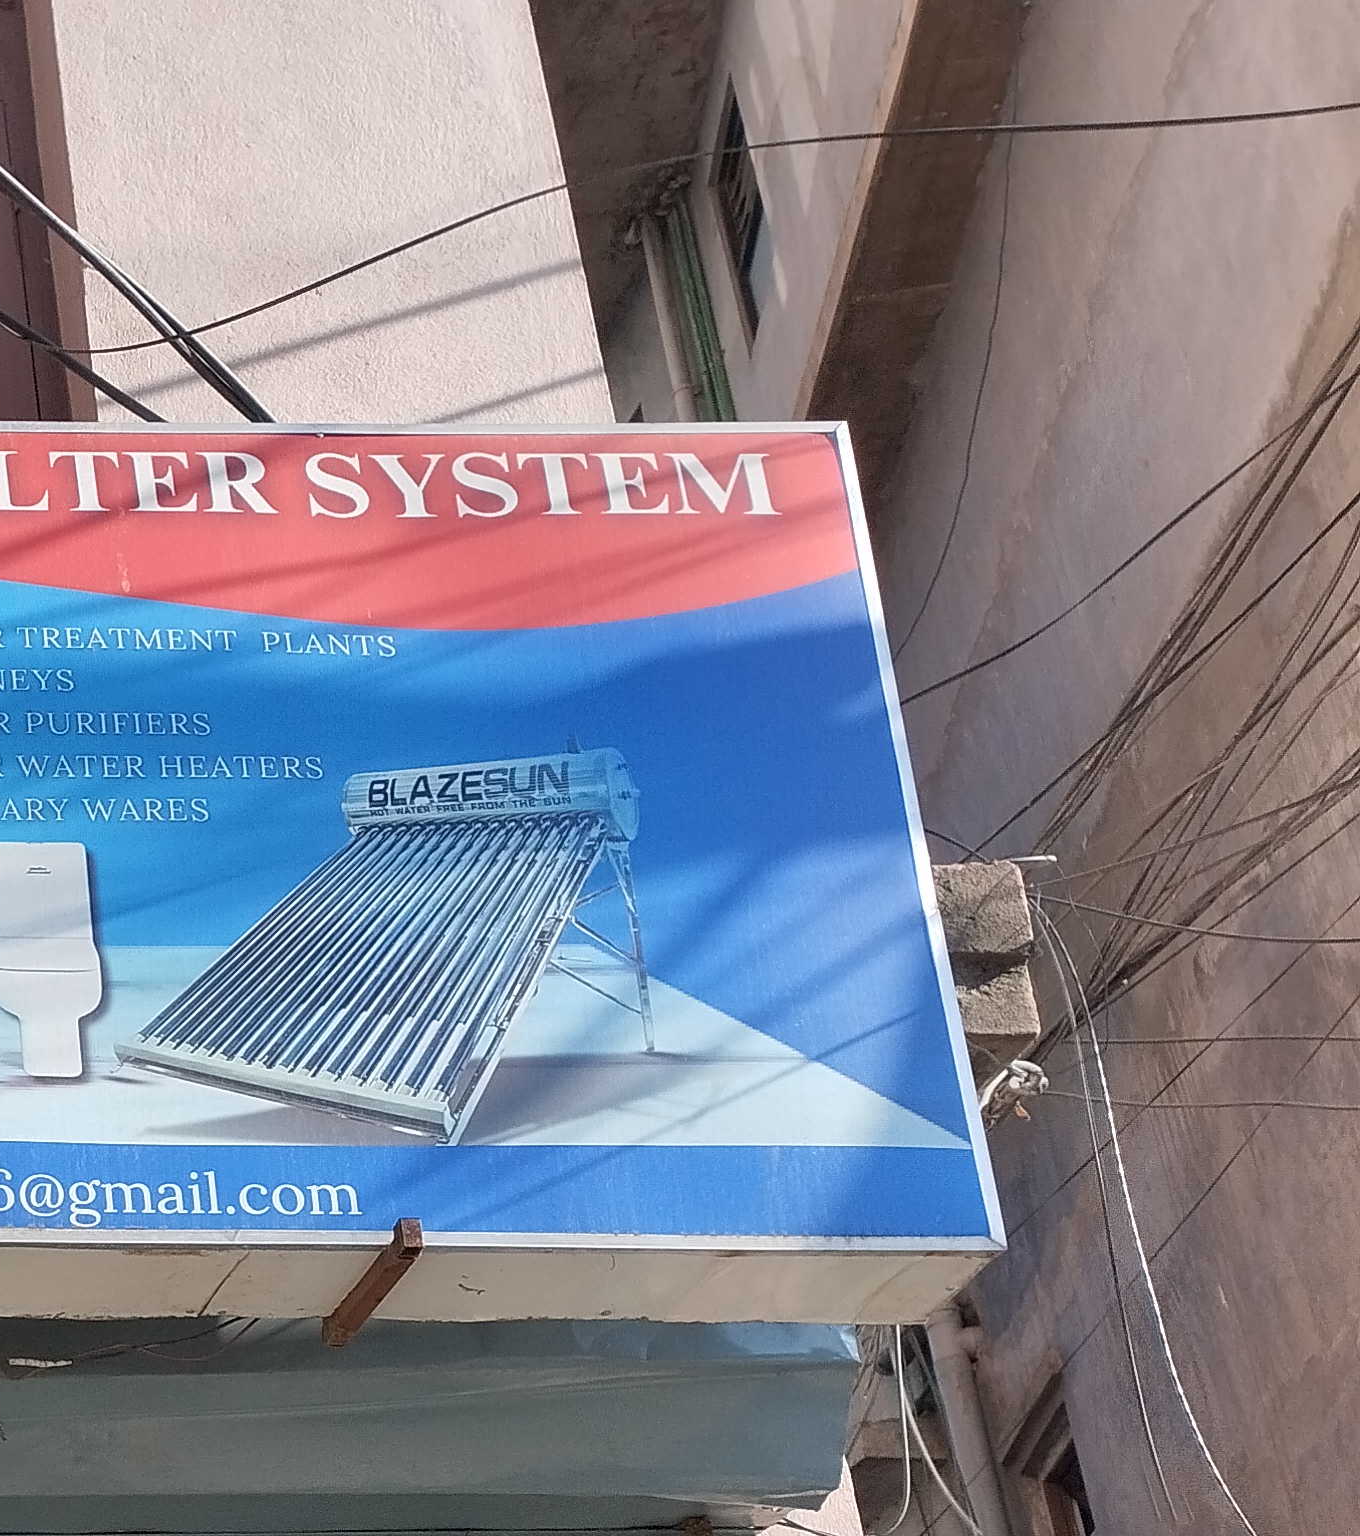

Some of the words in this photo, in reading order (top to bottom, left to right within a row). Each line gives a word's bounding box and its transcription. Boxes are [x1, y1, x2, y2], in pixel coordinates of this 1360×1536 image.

[308, 452, 782, 518] SYSTEM
[18, 626, 237, 653] TREATMENT
[262, 631, 398, 658] PLANTS
[24, 711, 211, 737] PURIFIERS
[19, 754, 147, 780] WATER
[158, 755, 325, 781] HEATERS
[368, 761, 570, 808] BLAZESUN
[82, 797, 209, 824] WARES
[395, 805, 431, 816] WATER
[437, 803, 465, 813] FREE
[471, 800, 506, 811] FROM
[512, 798, 537, 809] THE
